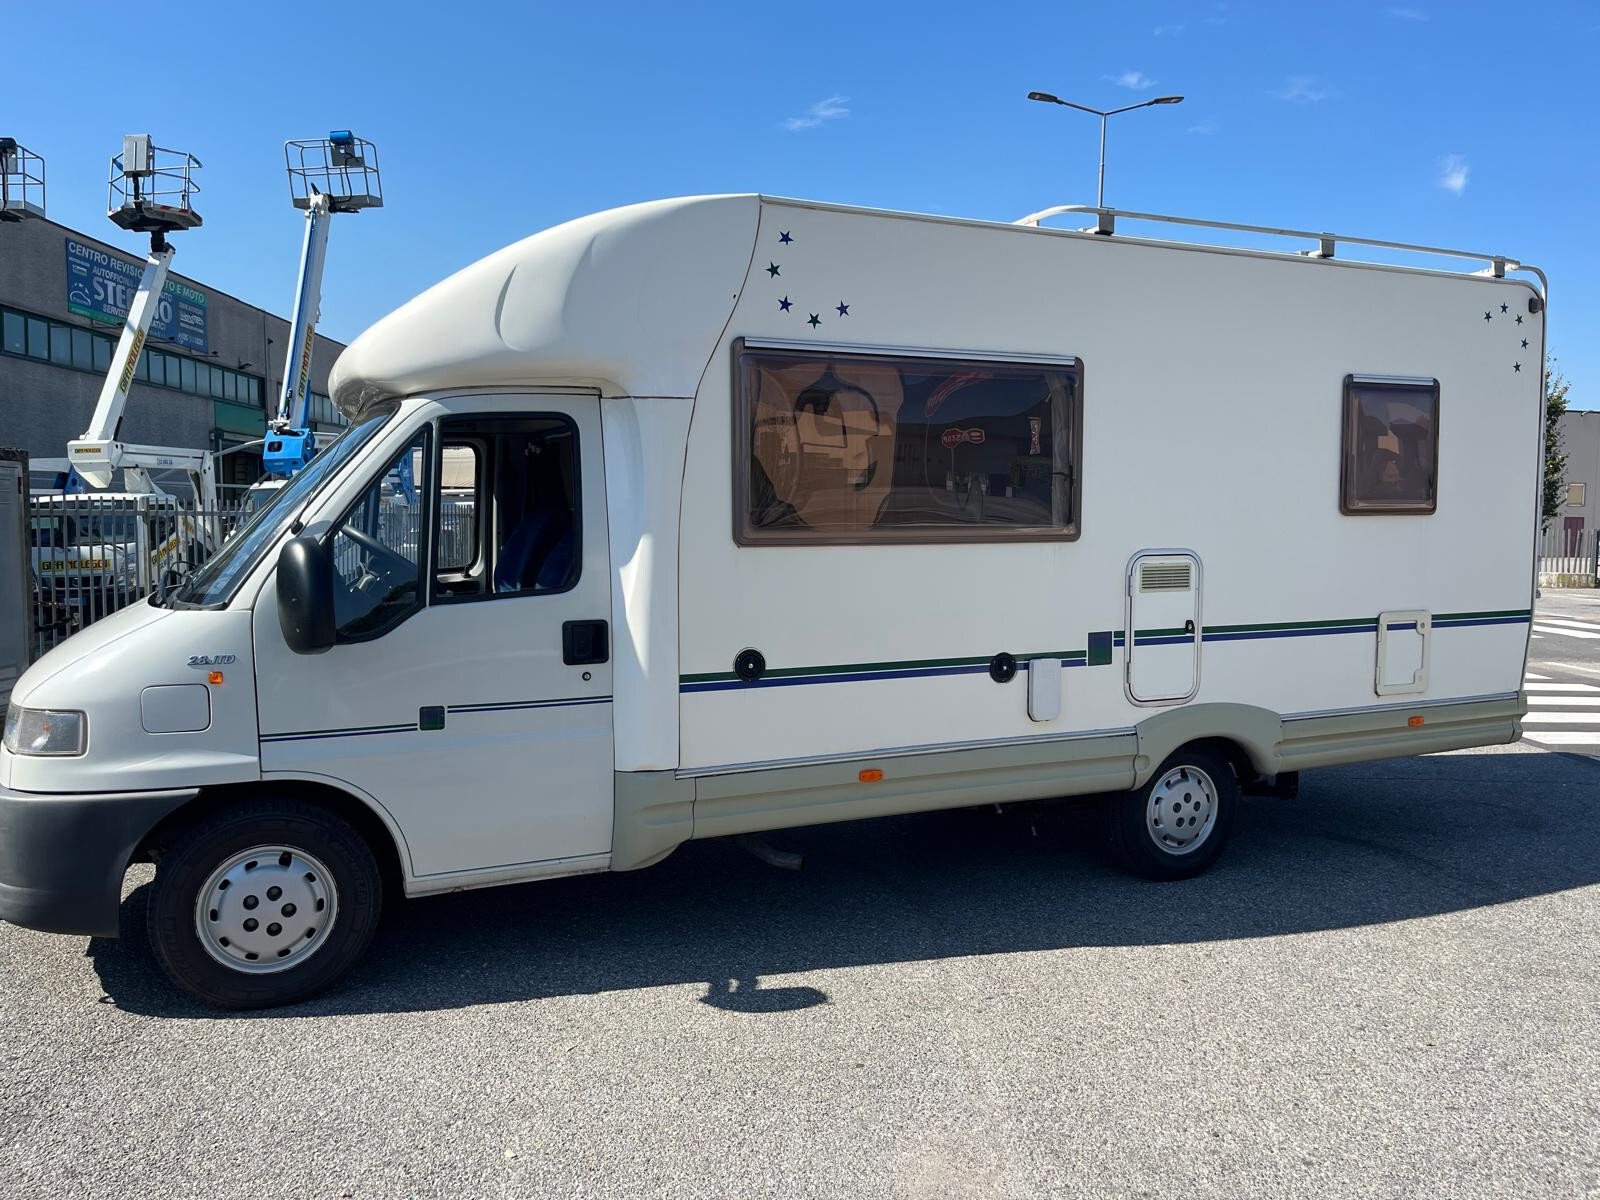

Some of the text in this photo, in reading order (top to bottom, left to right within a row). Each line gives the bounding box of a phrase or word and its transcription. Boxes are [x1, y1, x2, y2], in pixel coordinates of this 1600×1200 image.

[68, 242, 108, 265] CENTRO
[176, 284, 182, 294] E
[182, 287, 205, 303] MOTO
